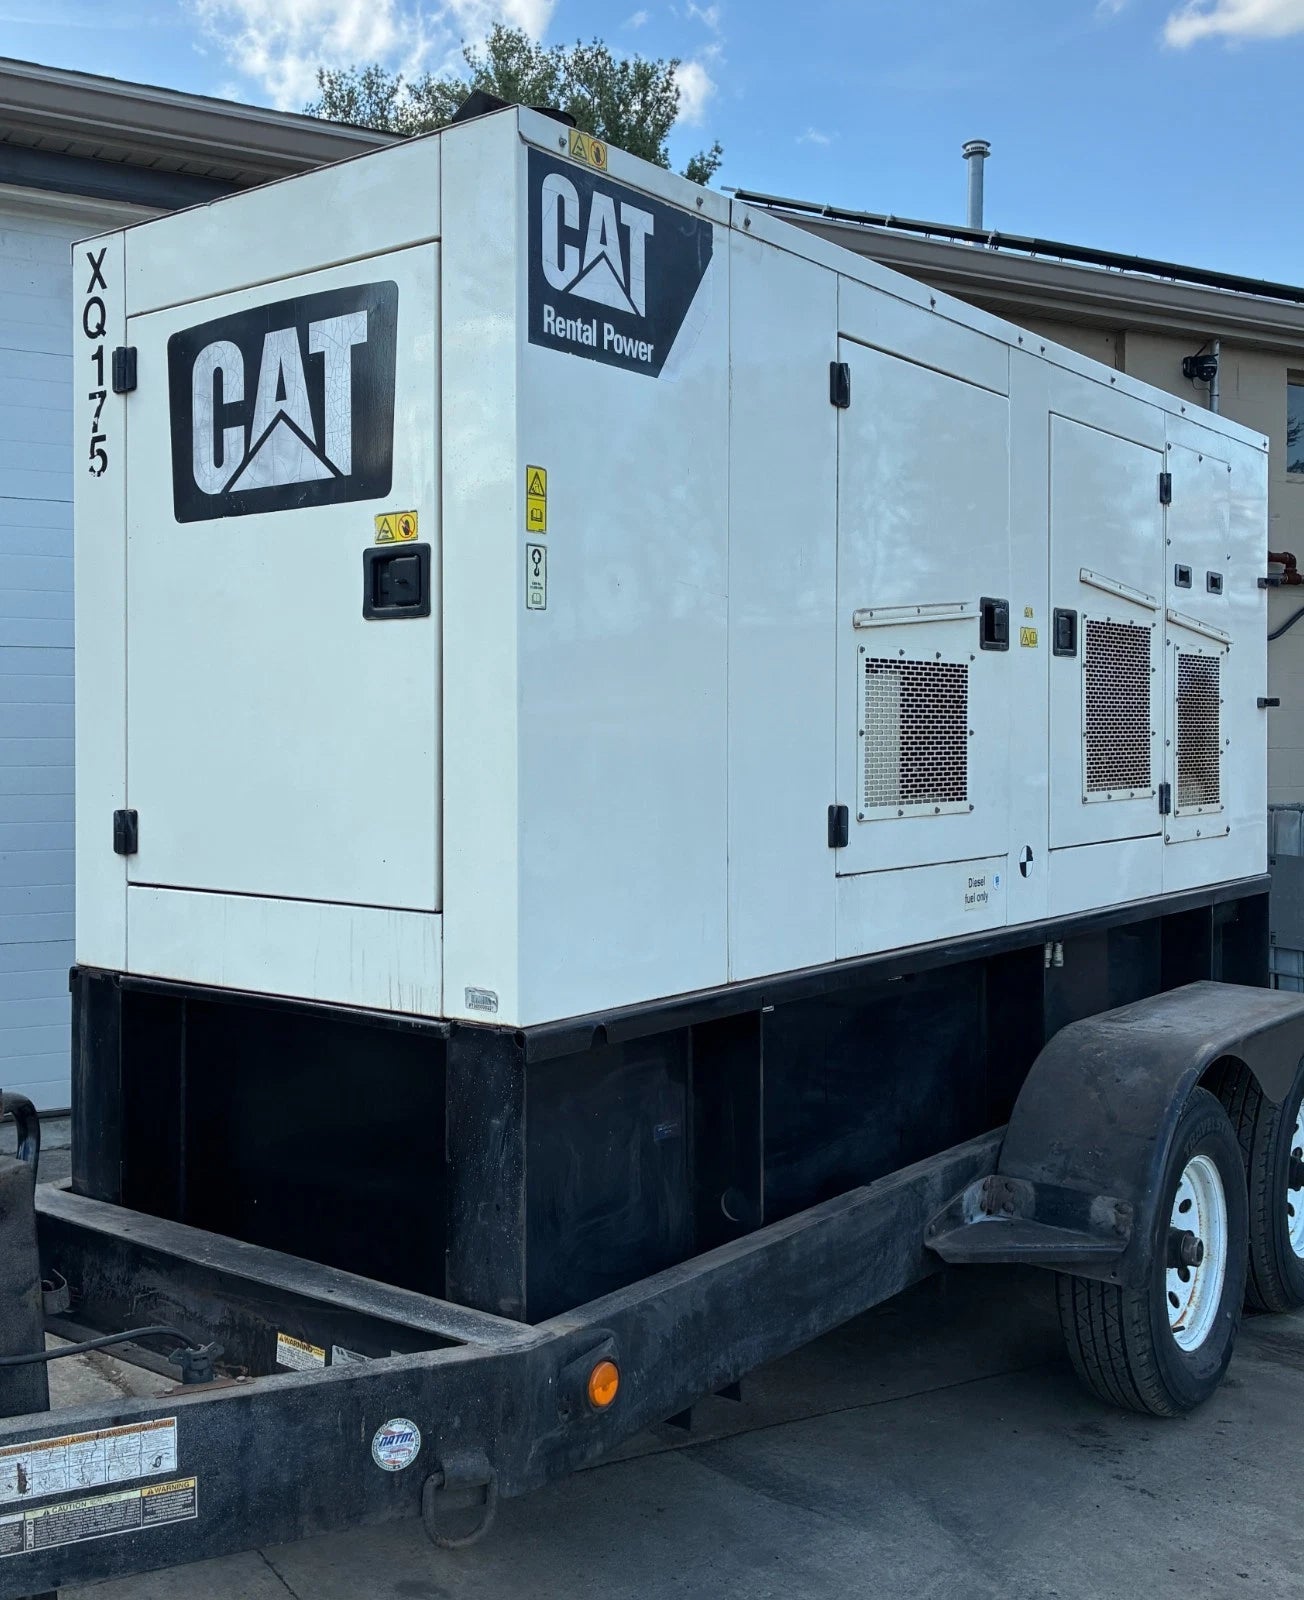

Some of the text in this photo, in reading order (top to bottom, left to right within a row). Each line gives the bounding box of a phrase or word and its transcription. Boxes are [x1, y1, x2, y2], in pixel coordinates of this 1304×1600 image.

[541, 173, 654, 318] CAT
[543, 303, 654, 363] Rental Power
[82, 247, 108, 478] XQ175
[192, 310, 368, 495] CAT
[968, 876, 985, 888] Diesel
[965, 891, 988, 904] fuel only
[284, 1336, 313, 1353] WARNING
[154, 1481, 190, 1493] WARNING
[52, 1502, 87, 1514] CAUTION
